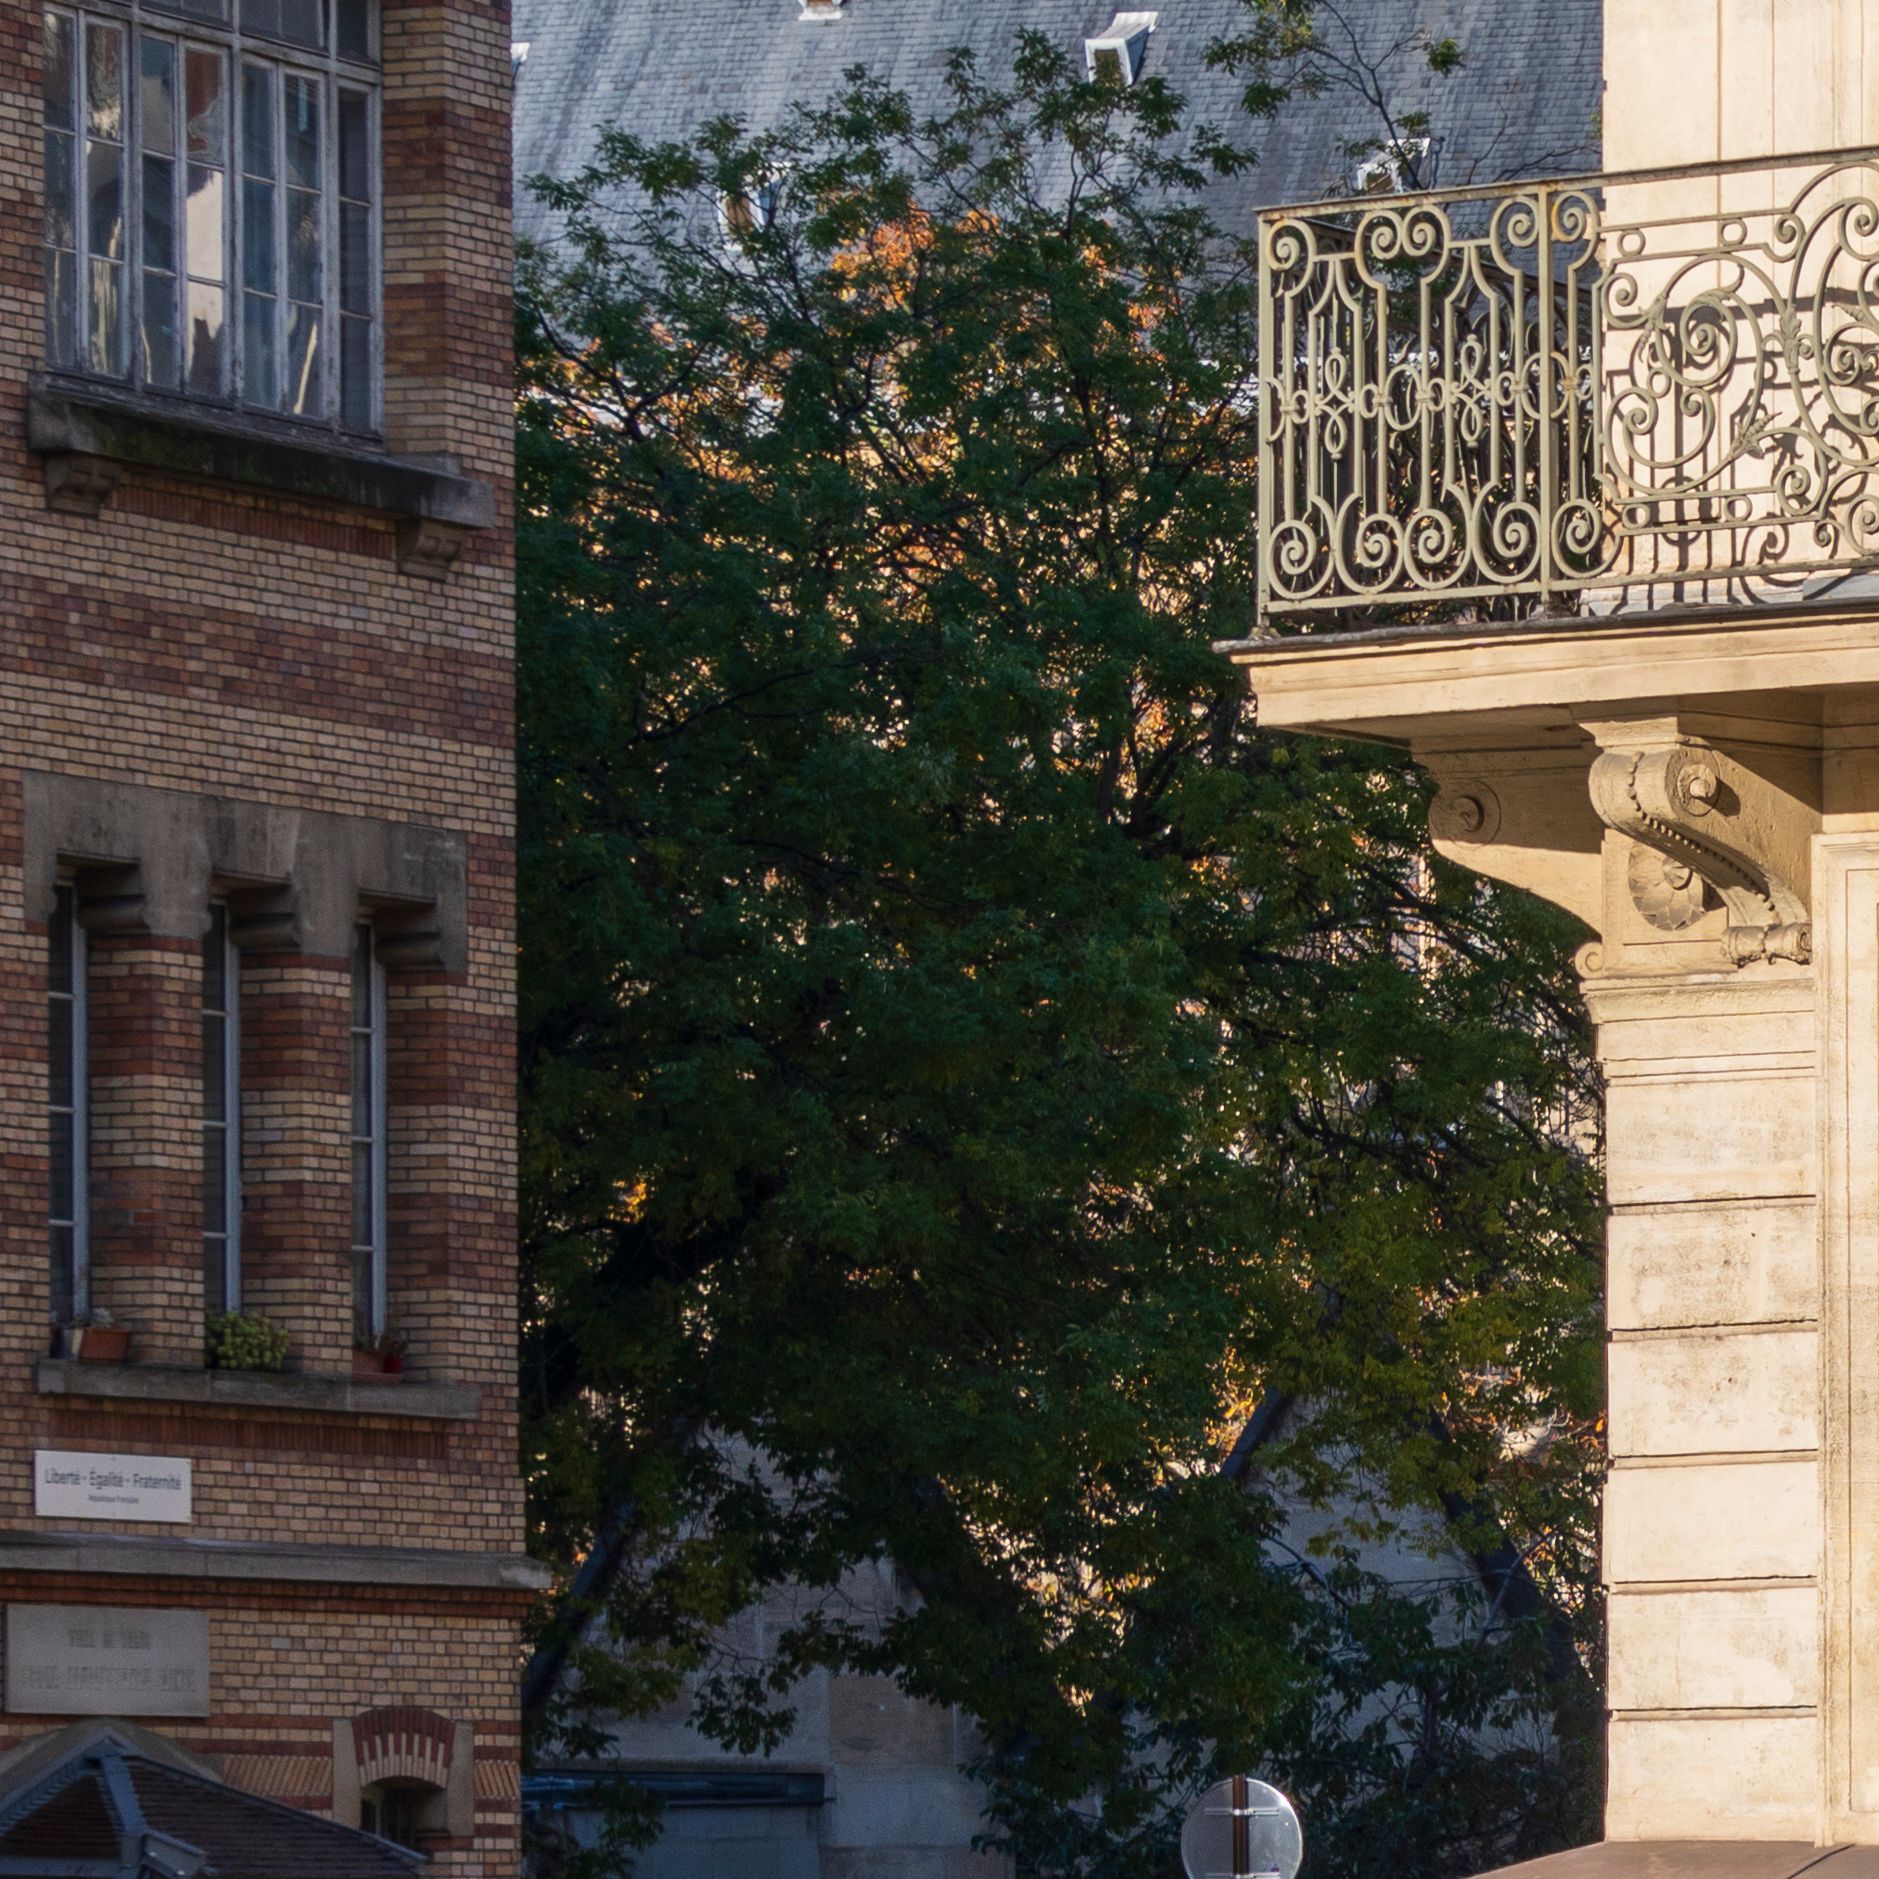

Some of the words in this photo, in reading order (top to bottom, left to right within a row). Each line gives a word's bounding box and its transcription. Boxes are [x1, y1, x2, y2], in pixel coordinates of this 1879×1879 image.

[45, 1467, 80, 1486] Liberté
[89, 1466, 124, 1490] Égalité
[133, 1472, 182, 1490] Fraternité
